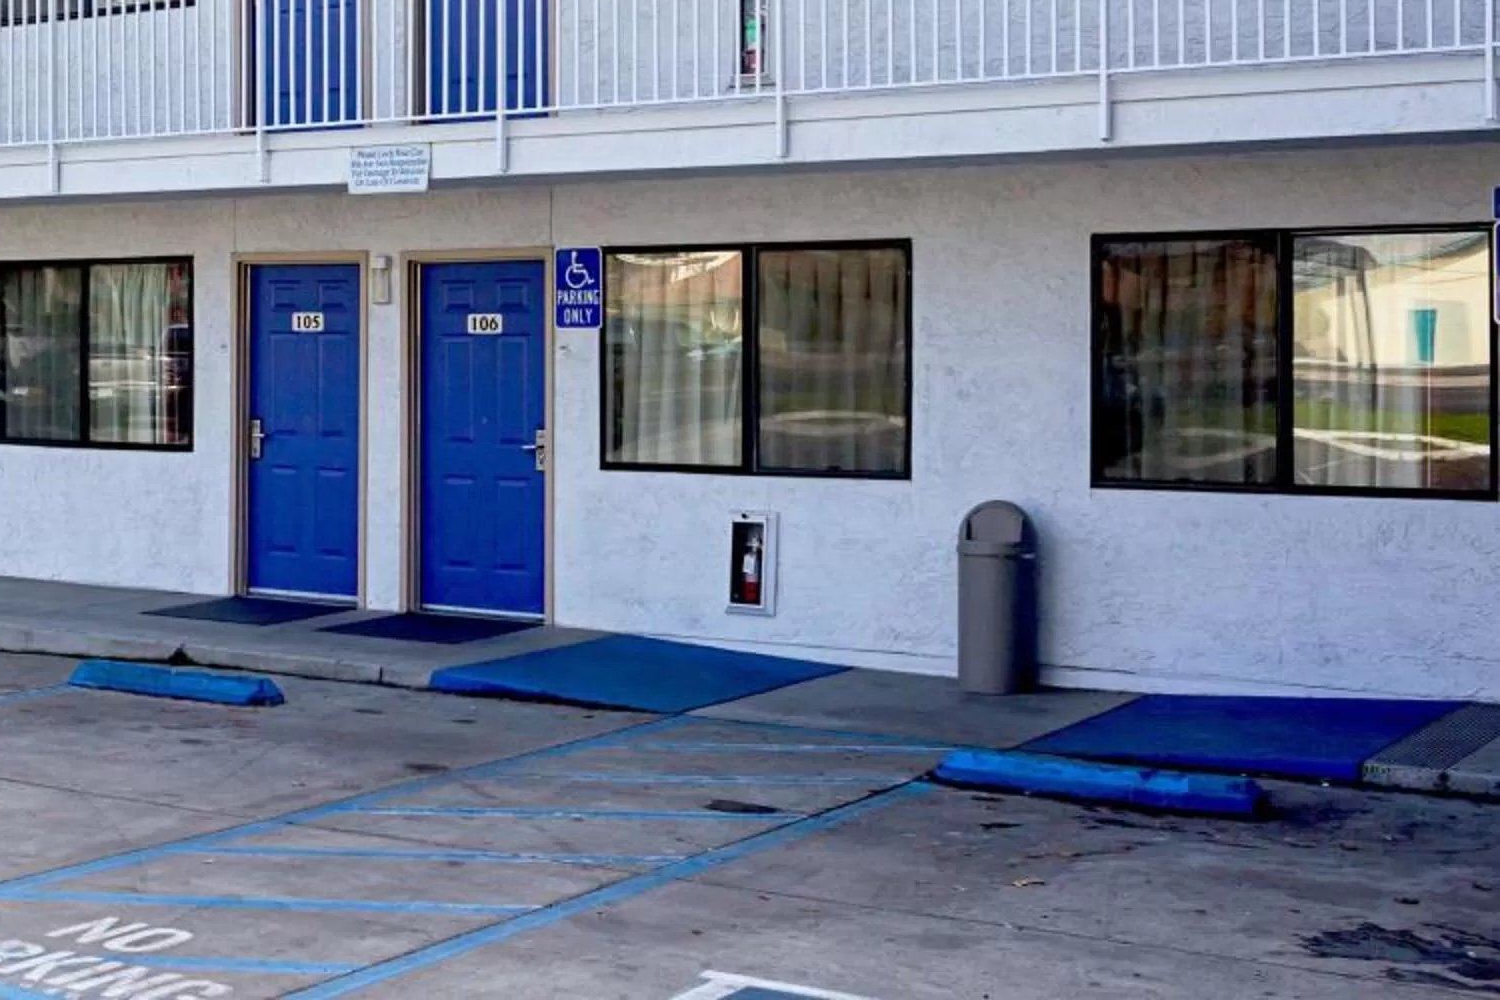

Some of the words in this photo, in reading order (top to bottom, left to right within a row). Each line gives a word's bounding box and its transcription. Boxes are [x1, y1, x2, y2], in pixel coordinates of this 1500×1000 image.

[557, 289, 600, 305] PARKING
[295, 315, 321, 329] 105
[471, 316, 499, 331] 106
[563, 308, 593, 324] ONLY
[44, 916, 193, 952] NO
